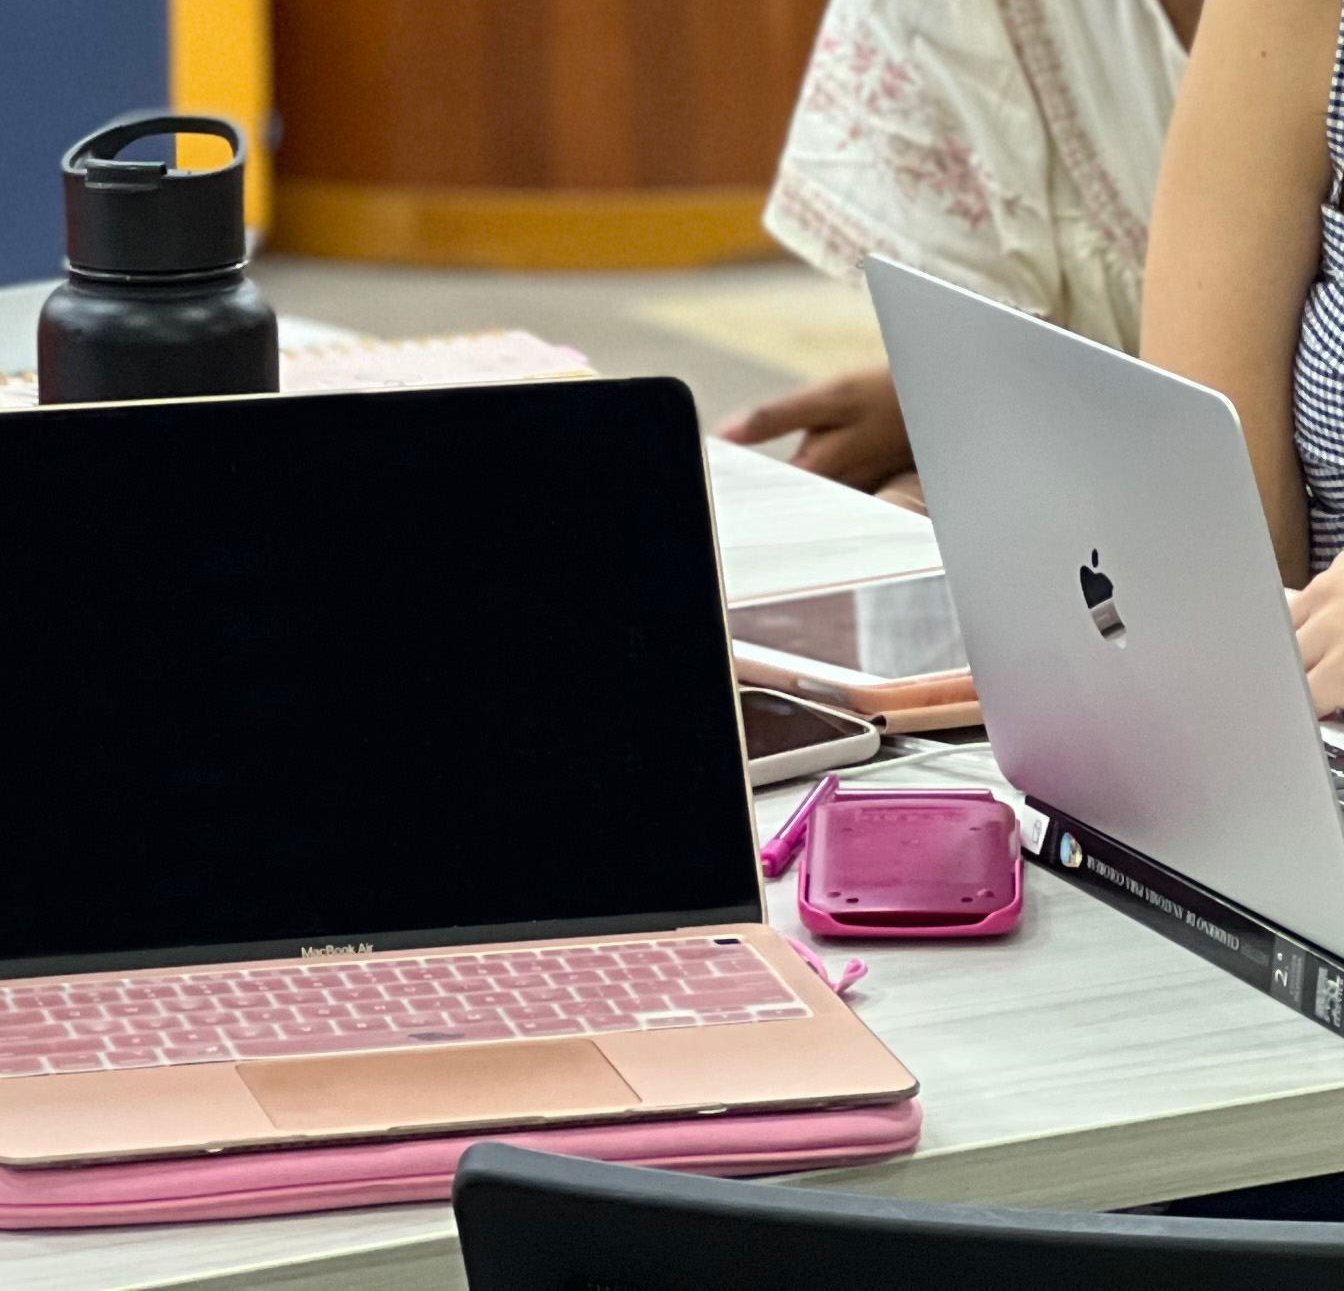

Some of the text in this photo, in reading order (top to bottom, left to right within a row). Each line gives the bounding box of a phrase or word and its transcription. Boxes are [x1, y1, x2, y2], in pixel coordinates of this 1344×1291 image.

[1185, 910, 1196, 927] DE
[1197, 916, 1240, 951] CUADERNO
[300, 942, 374, 959] MacBook Air
